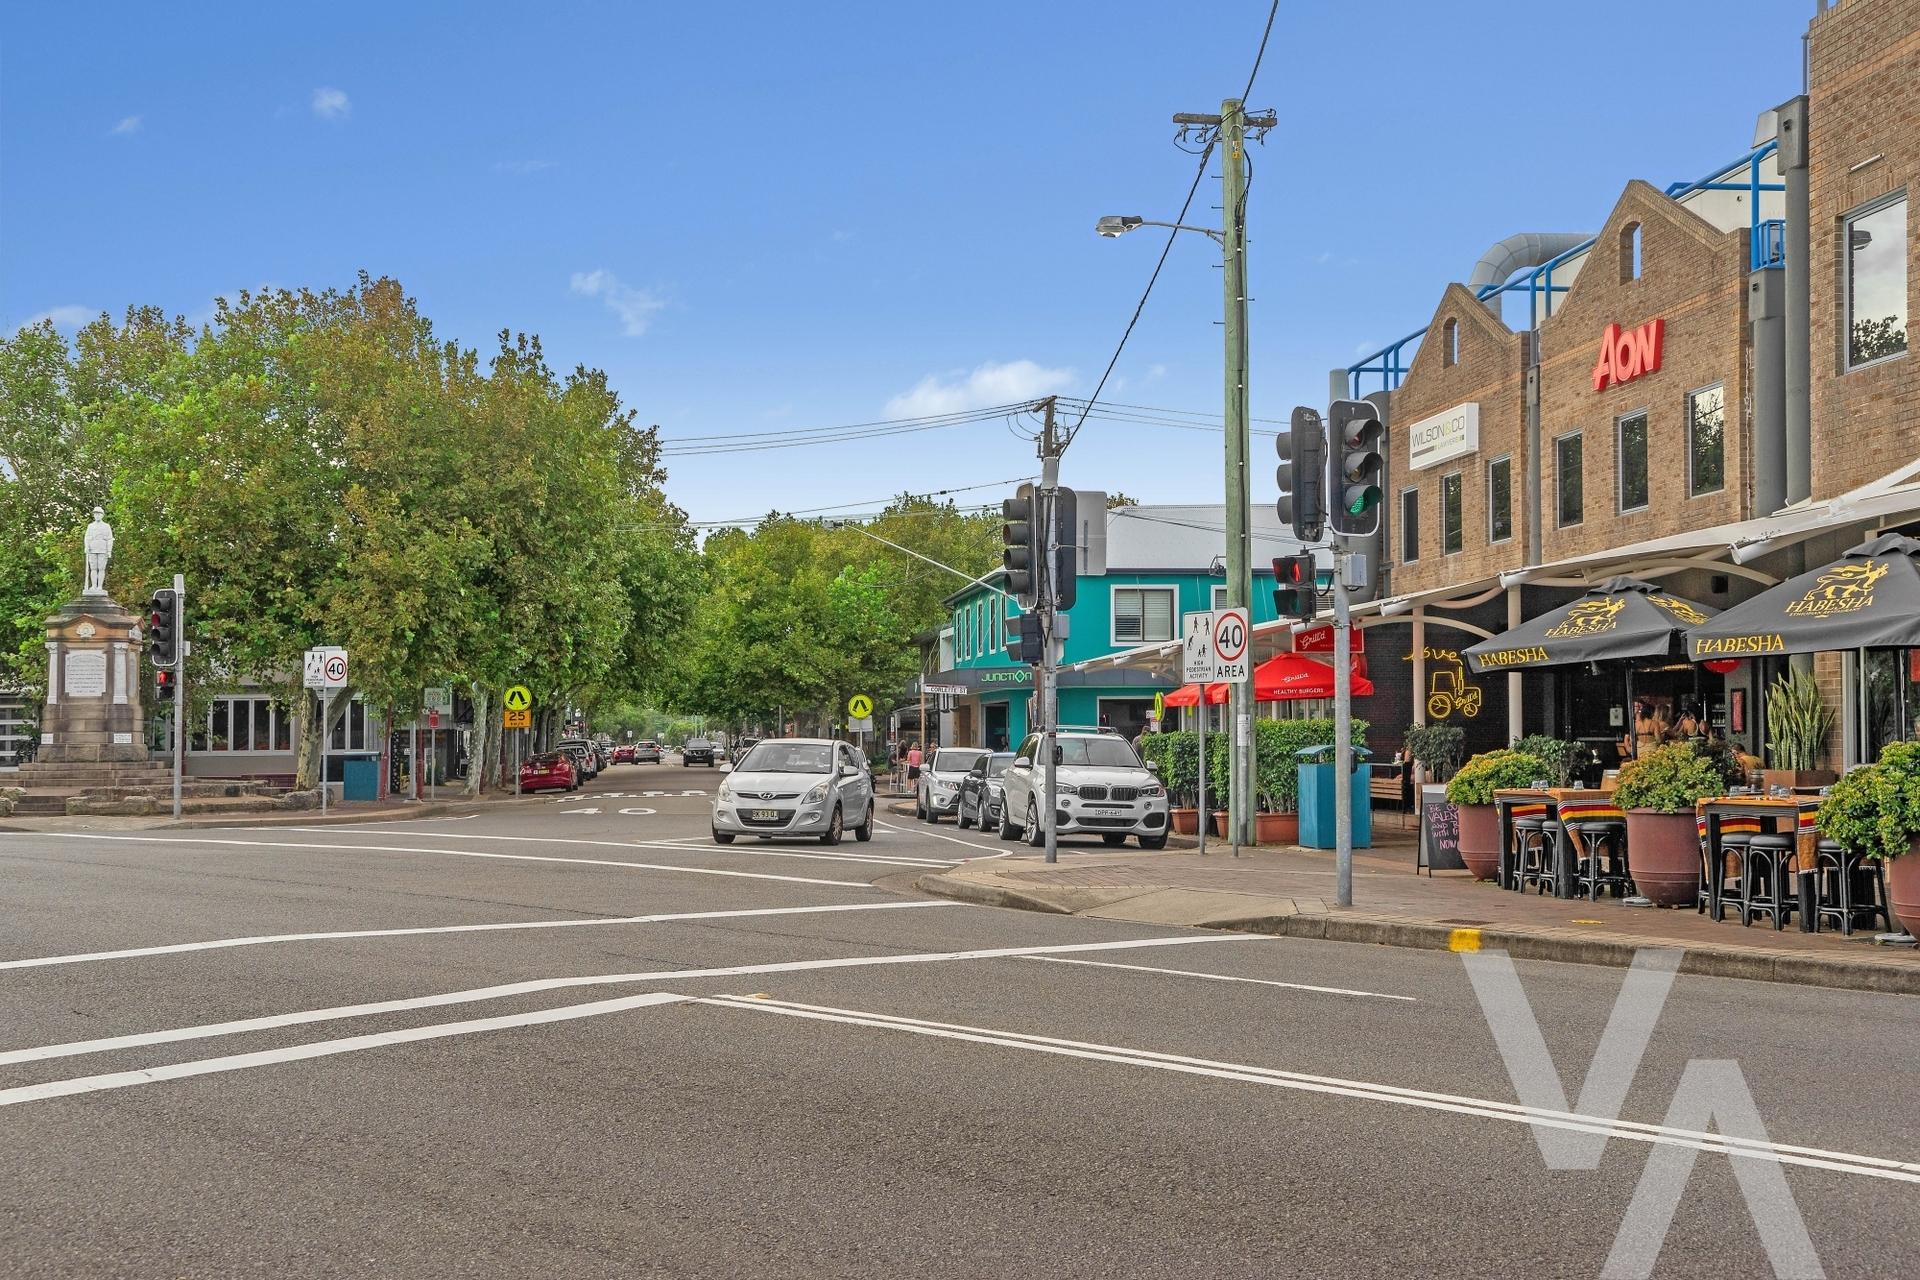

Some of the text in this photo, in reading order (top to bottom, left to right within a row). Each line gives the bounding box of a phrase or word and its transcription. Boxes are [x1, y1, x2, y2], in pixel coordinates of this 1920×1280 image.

[1784, 595, 1874, 613] HABESHA
[1219, 625, 1243, 649] 40
[1544, 621, 1617, 637] HABESHA
[1696, 634, 1785, 655] HABESHA
[1478, 646, 1549, 668] HABESHA
[328, 663, 344, 675] 40
[1216, 665, 1246, 678] AREA
[509, 711, 525, 721] 25
[1439, 839, 1456, 850] NOW
